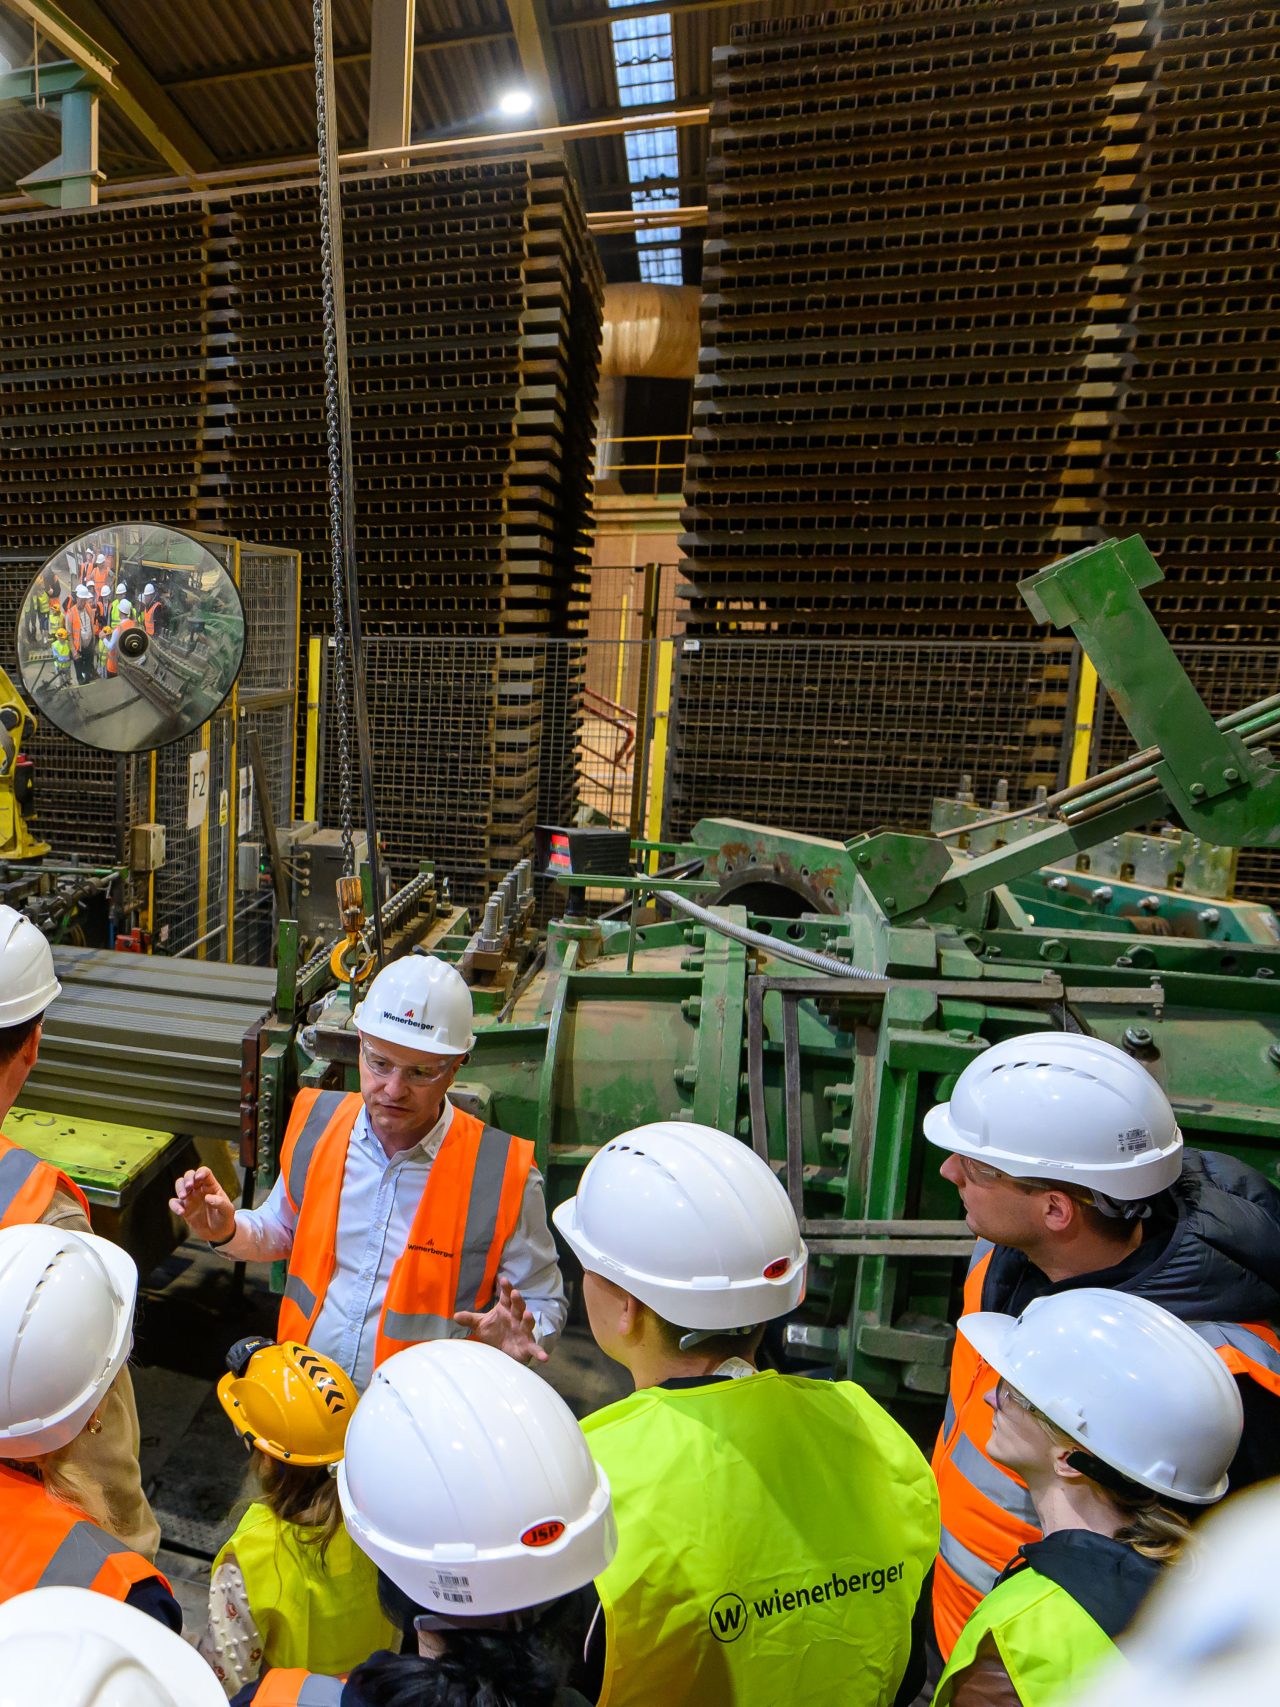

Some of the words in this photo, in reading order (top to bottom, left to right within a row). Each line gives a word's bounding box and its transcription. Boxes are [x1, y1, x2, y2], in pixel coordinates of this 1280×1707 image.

[193, 771, 205, 799] F2
[383, 1011, 434, 1030] Wienerberger
[530, 1524, 559, 1543] JSP
[754, 1561, 904, 1619] wienerberger
